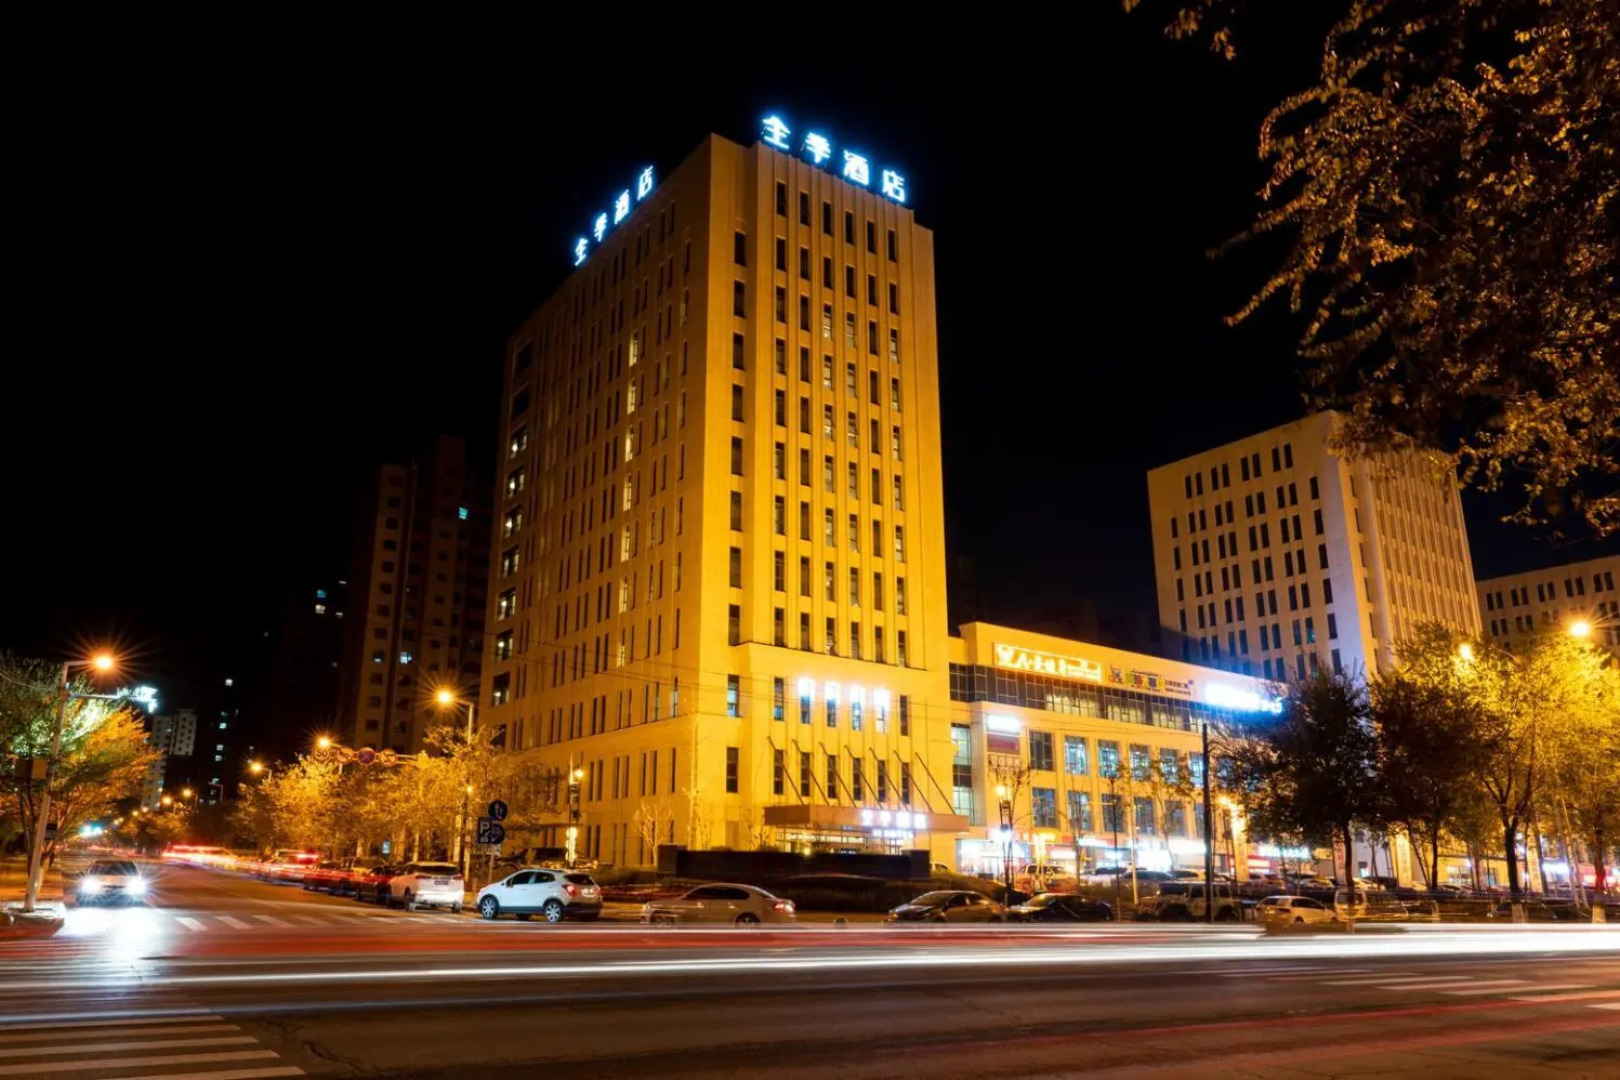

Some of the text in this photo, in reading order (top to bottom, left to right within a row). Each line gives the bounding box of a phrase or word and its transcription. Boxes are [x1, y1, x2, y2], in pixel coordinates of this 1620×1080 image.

[761, 115, 906, 203] 全季酒店
[574, 165, 654, 267] 全季酒店
